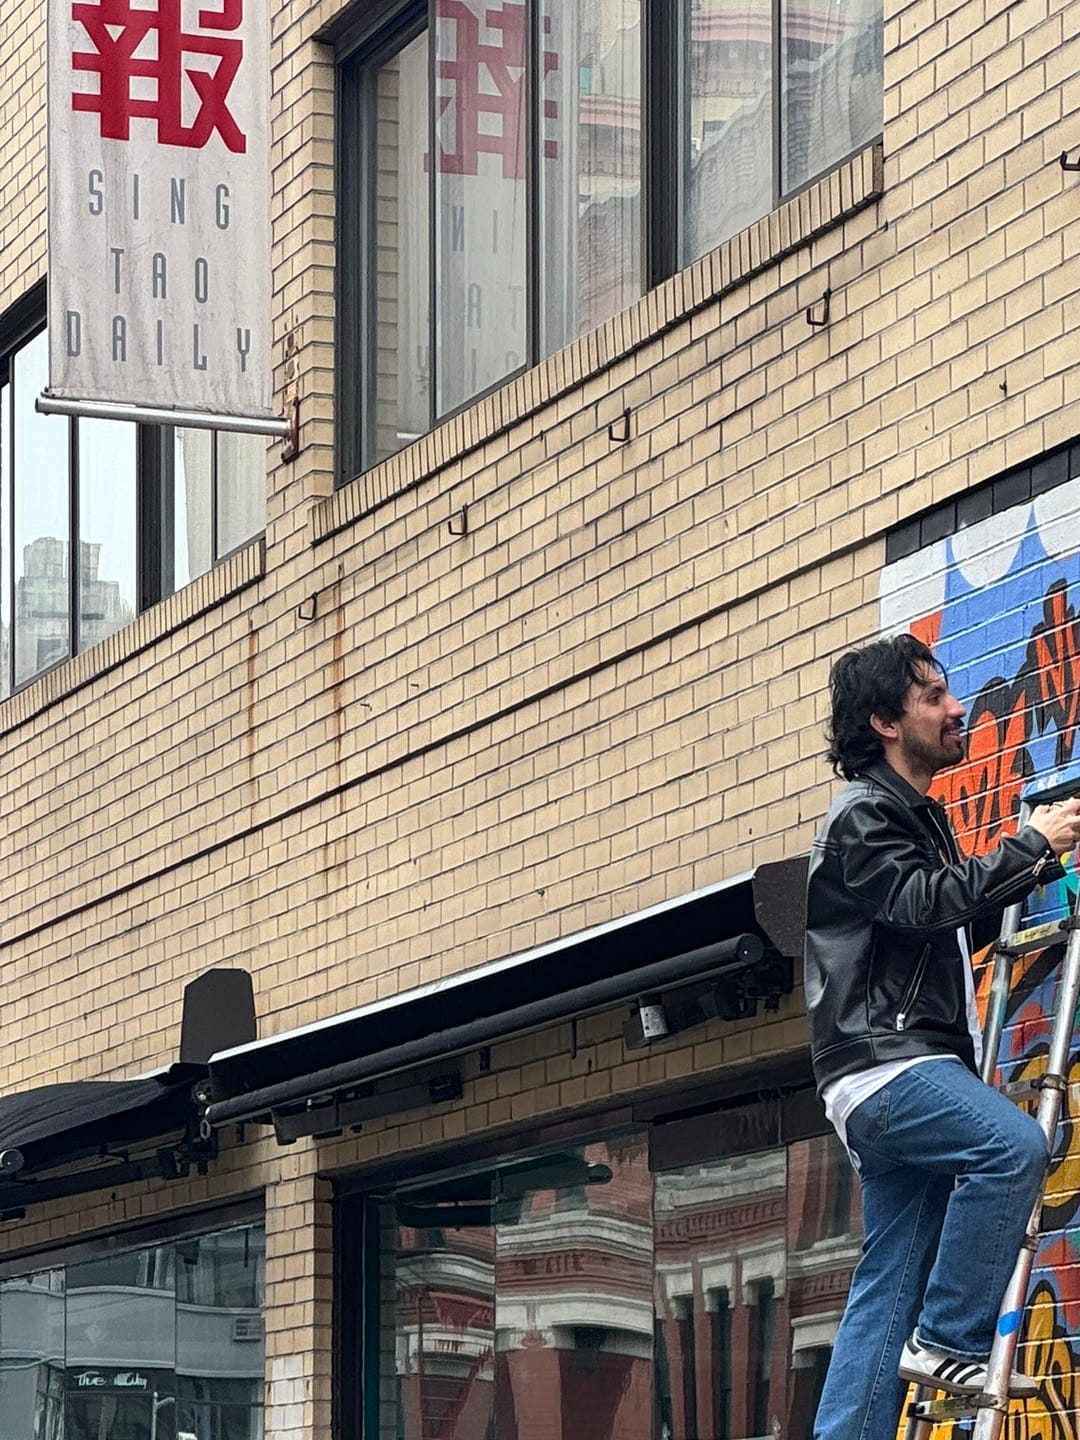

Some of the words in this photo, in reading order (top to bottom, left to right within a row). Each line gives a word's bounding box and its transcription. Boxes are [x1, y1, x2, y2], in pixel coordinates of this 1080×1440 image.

[88, 169, 230, 230] SING
[110, 247, 208, 304] TAO
[66, 310, 250, 373] DAILY
